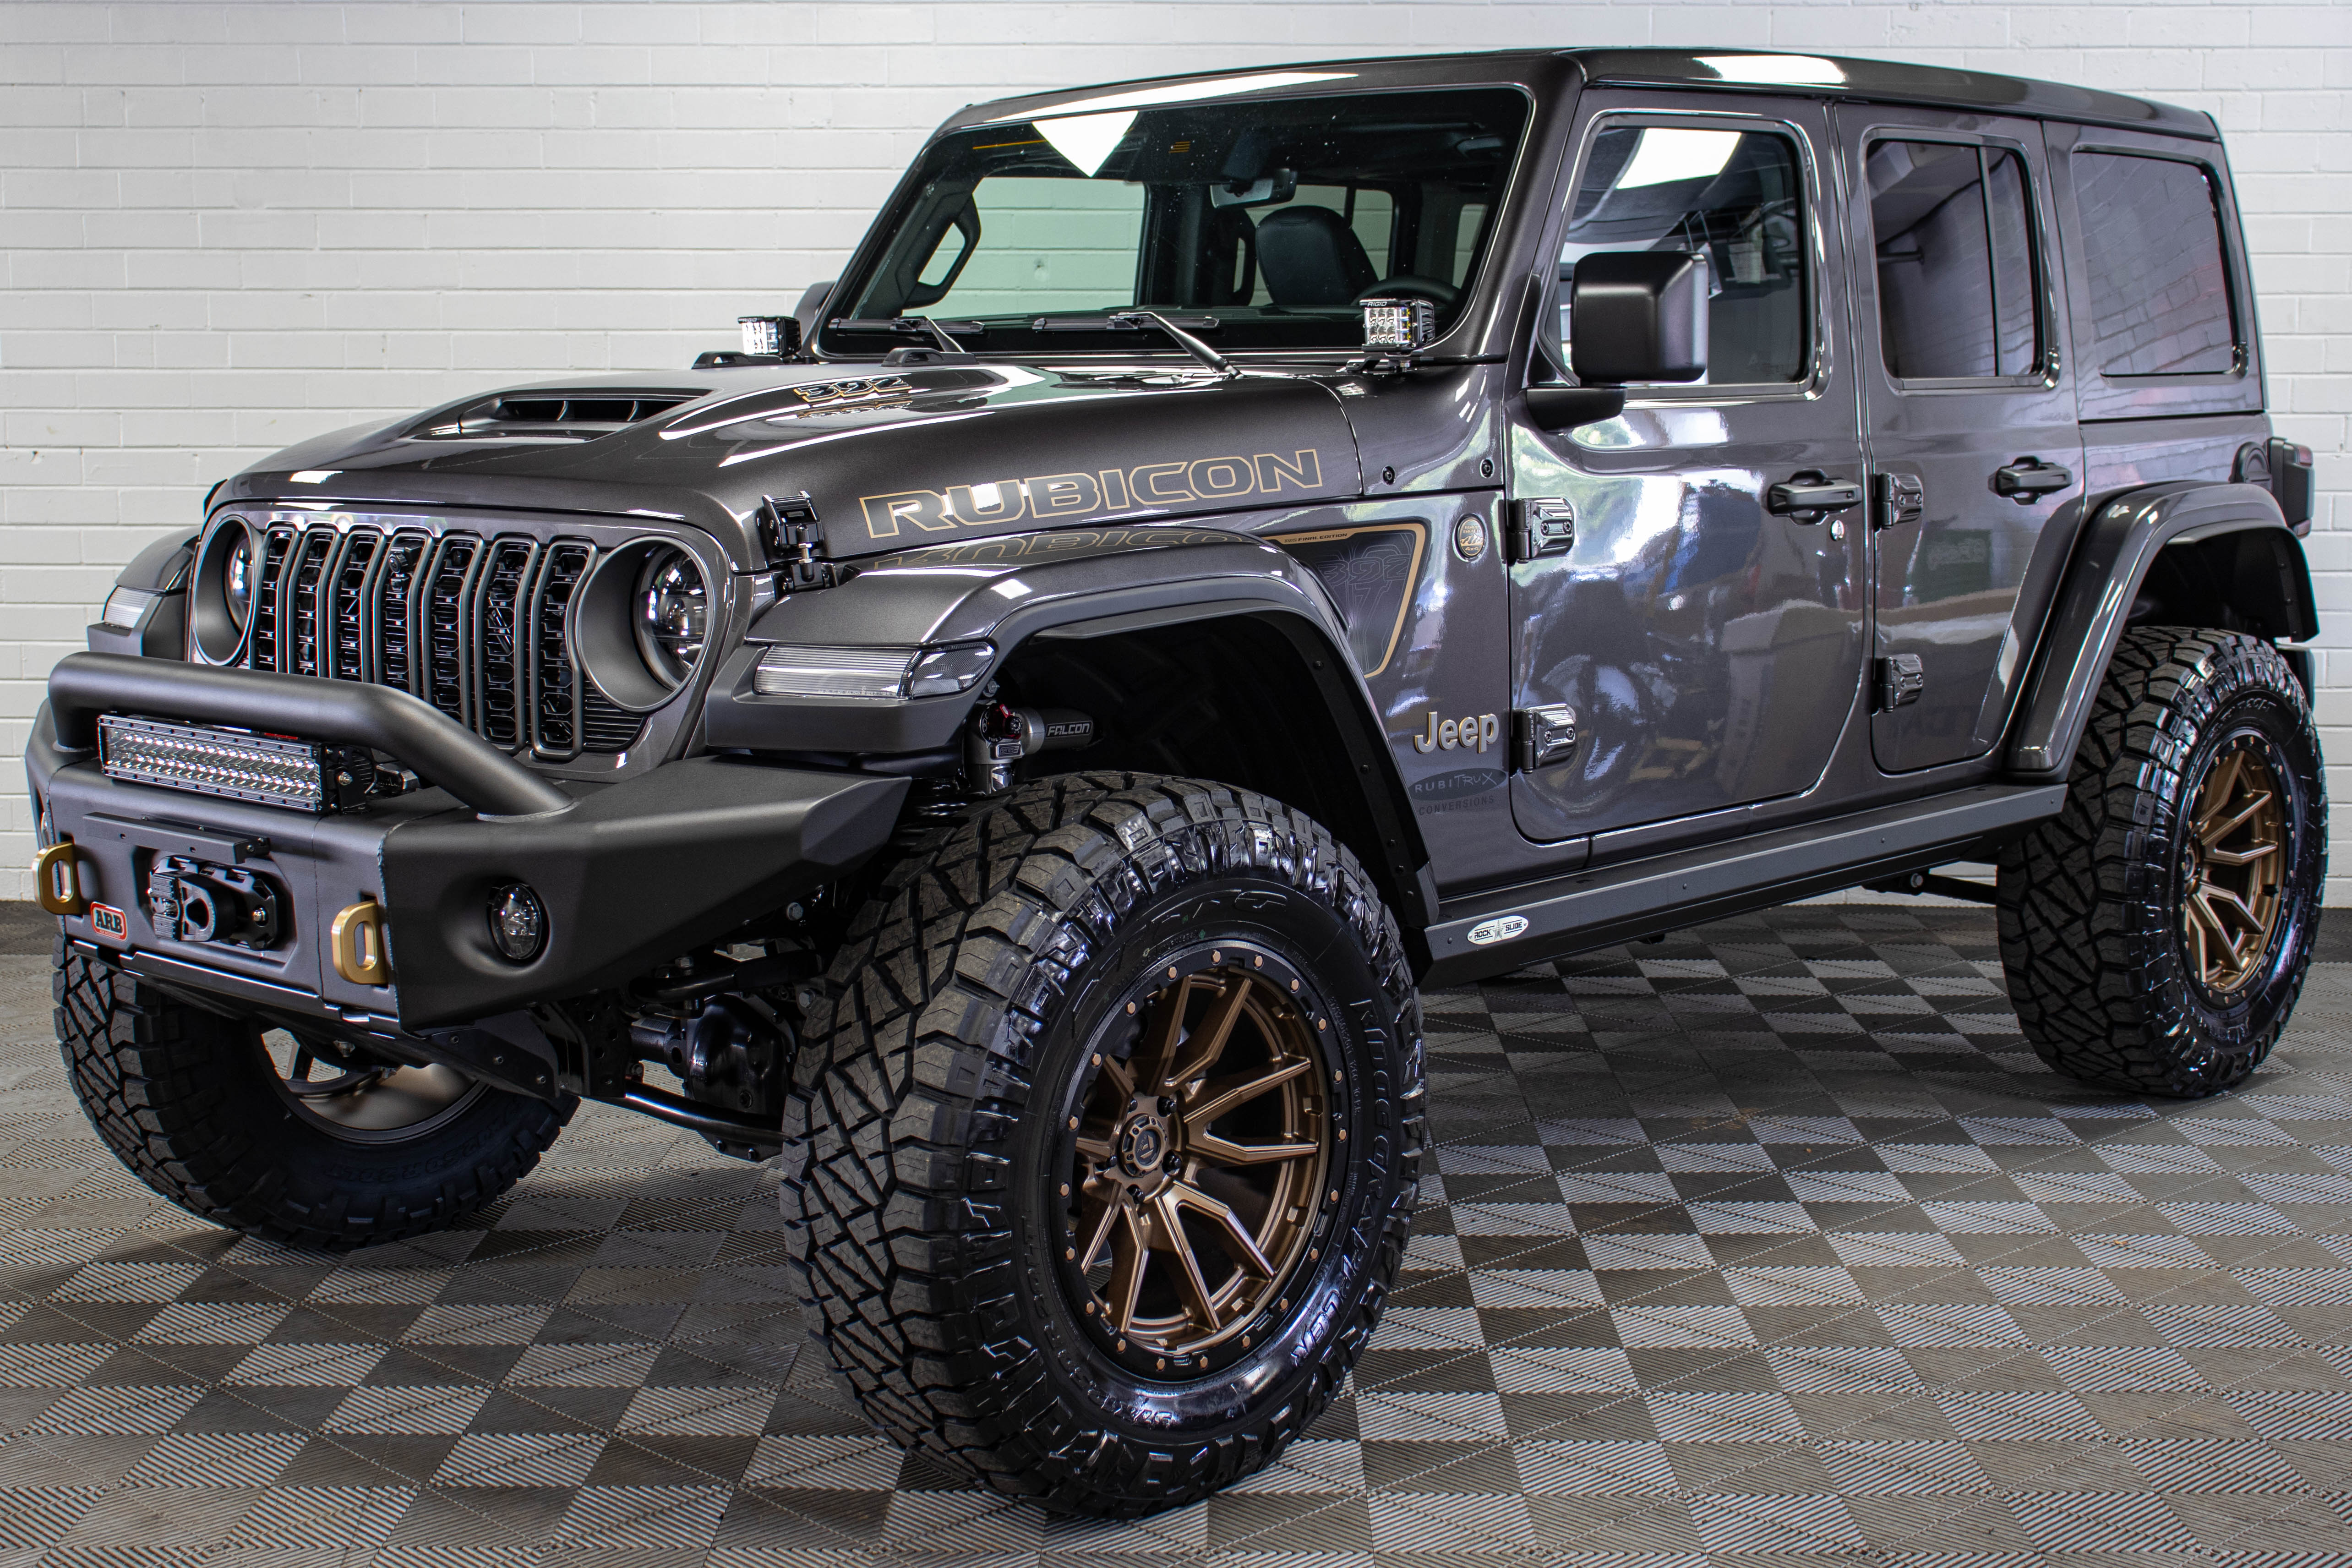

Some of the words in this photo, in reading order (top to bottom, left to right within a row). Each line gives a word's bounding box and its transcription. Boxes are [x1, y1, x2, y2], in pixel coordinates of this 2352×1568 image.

[794, 376, 912, 403] 392
[859, 448, 1322, 539] RUBICON
[1047, 723, 1090, 737] FALCON
[1414, 711, 1499, 754] Jeep
[1415, 772, 1498, 792] RUBITRUX
[1419, 795, 1494, 816] CONVERSIONS
[96, 909, 123, 934] ARB
[1474, 929, 1491, 939] ROCK
[1505, 922, 1522, 931] SLIDE
[1349, 999, 1392, 1130] RIDGE
[1290, 1134, 1391, 1367] GRAPPLER
